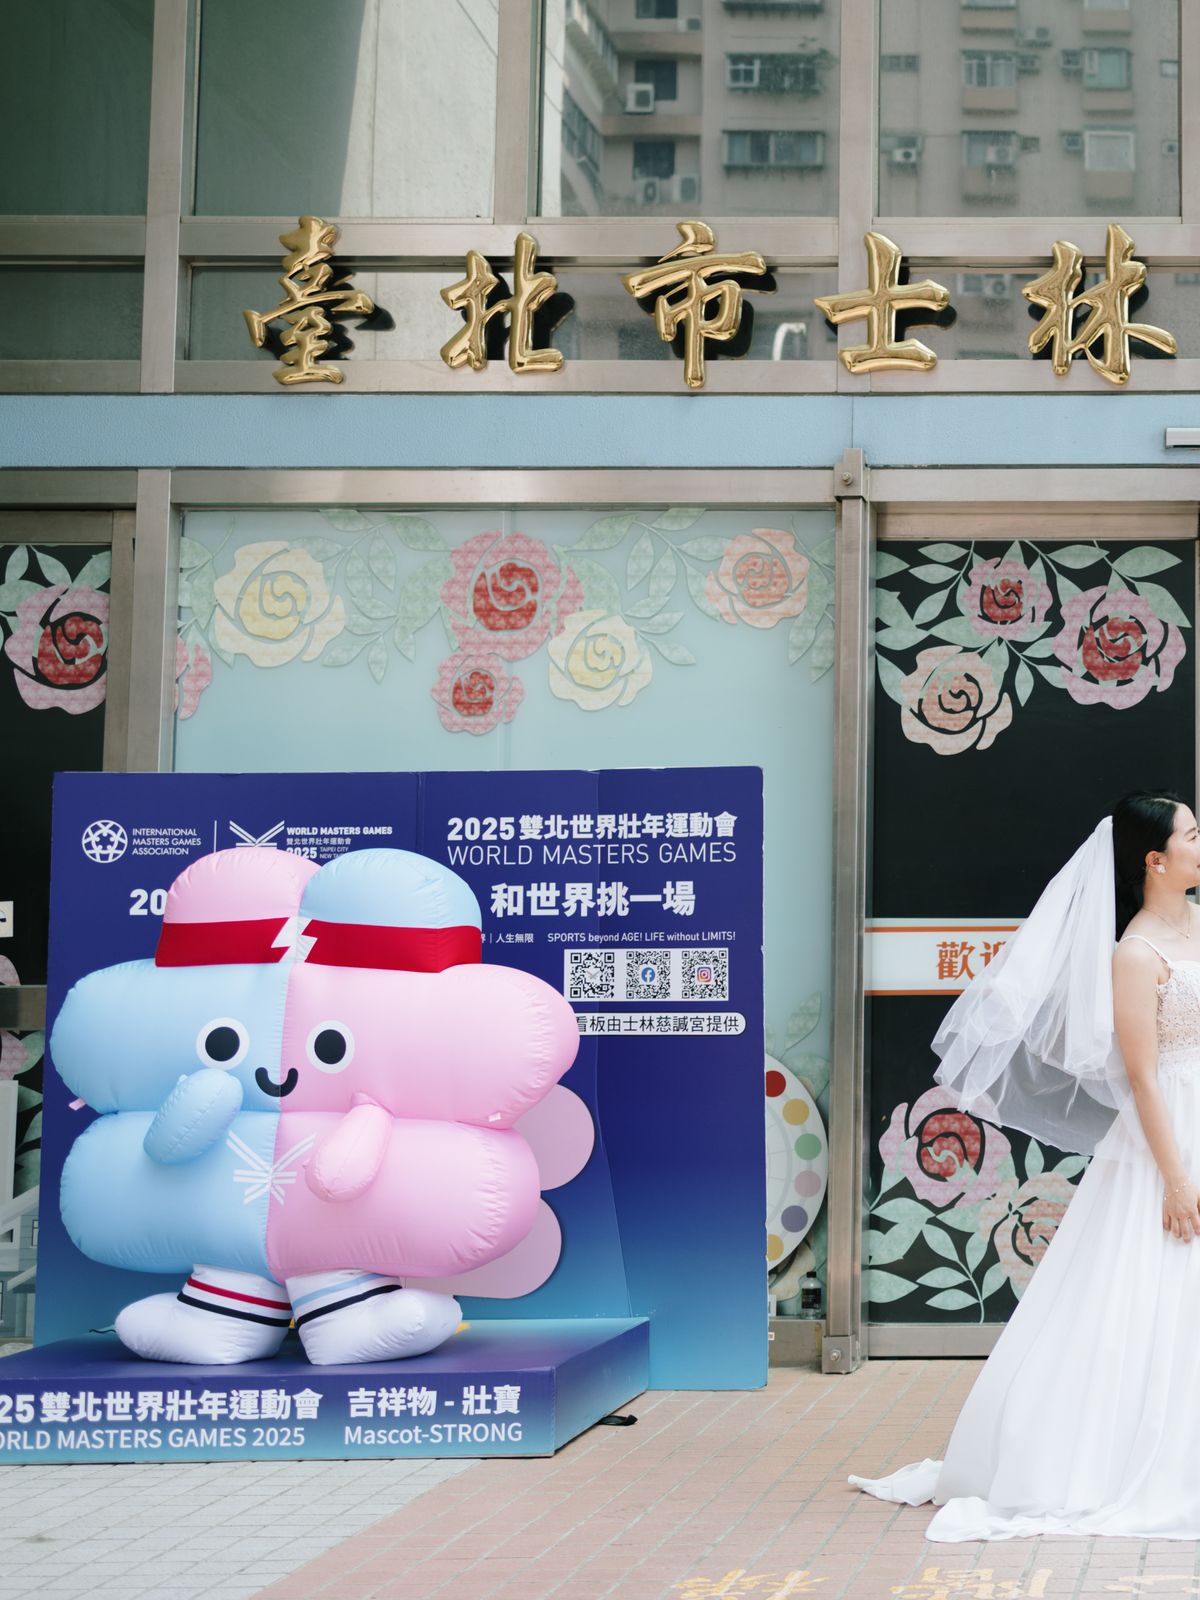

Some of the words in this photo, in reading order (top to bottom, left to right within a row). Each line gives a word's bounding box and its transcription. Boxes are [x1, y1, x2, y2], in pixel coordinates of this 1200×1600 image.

[132, 828, 198, 836] INTERNATIONAL
[286, 827, 318, 835] WORLD
[320, 827, 361, 835] MASTERS
[363, 826, 393, 835] GAMES
[132, 838, 170, 846] MASTERS
[171, 838, 202, 846] GAMES
[132, 848, 189, 856] ASSOCIATION
[447, 845, 533, 866] WORLD
[543, 843, 649, 865] MASTERS
[659, 841, 737, 863] GAMES
[490, 881, 696, 918] 和世界挑一場
[547, 932, 586, 942] SPORTS
[588, 932, 620, 944] beyond
[621, 932, 643, 942] AGE!
[645, 931, 665, 941] LIFE
[667, 932, 699, 941] without
[701, 931, 736, 941] LIMITS!
[58, 1428, 162, 1449] MASTERS
[168, 1427, 247, 1448] GAMES
[252, 1427, 306, 1447] 2025
[344, 1422, 523, 1445] Mascot-STRONG
